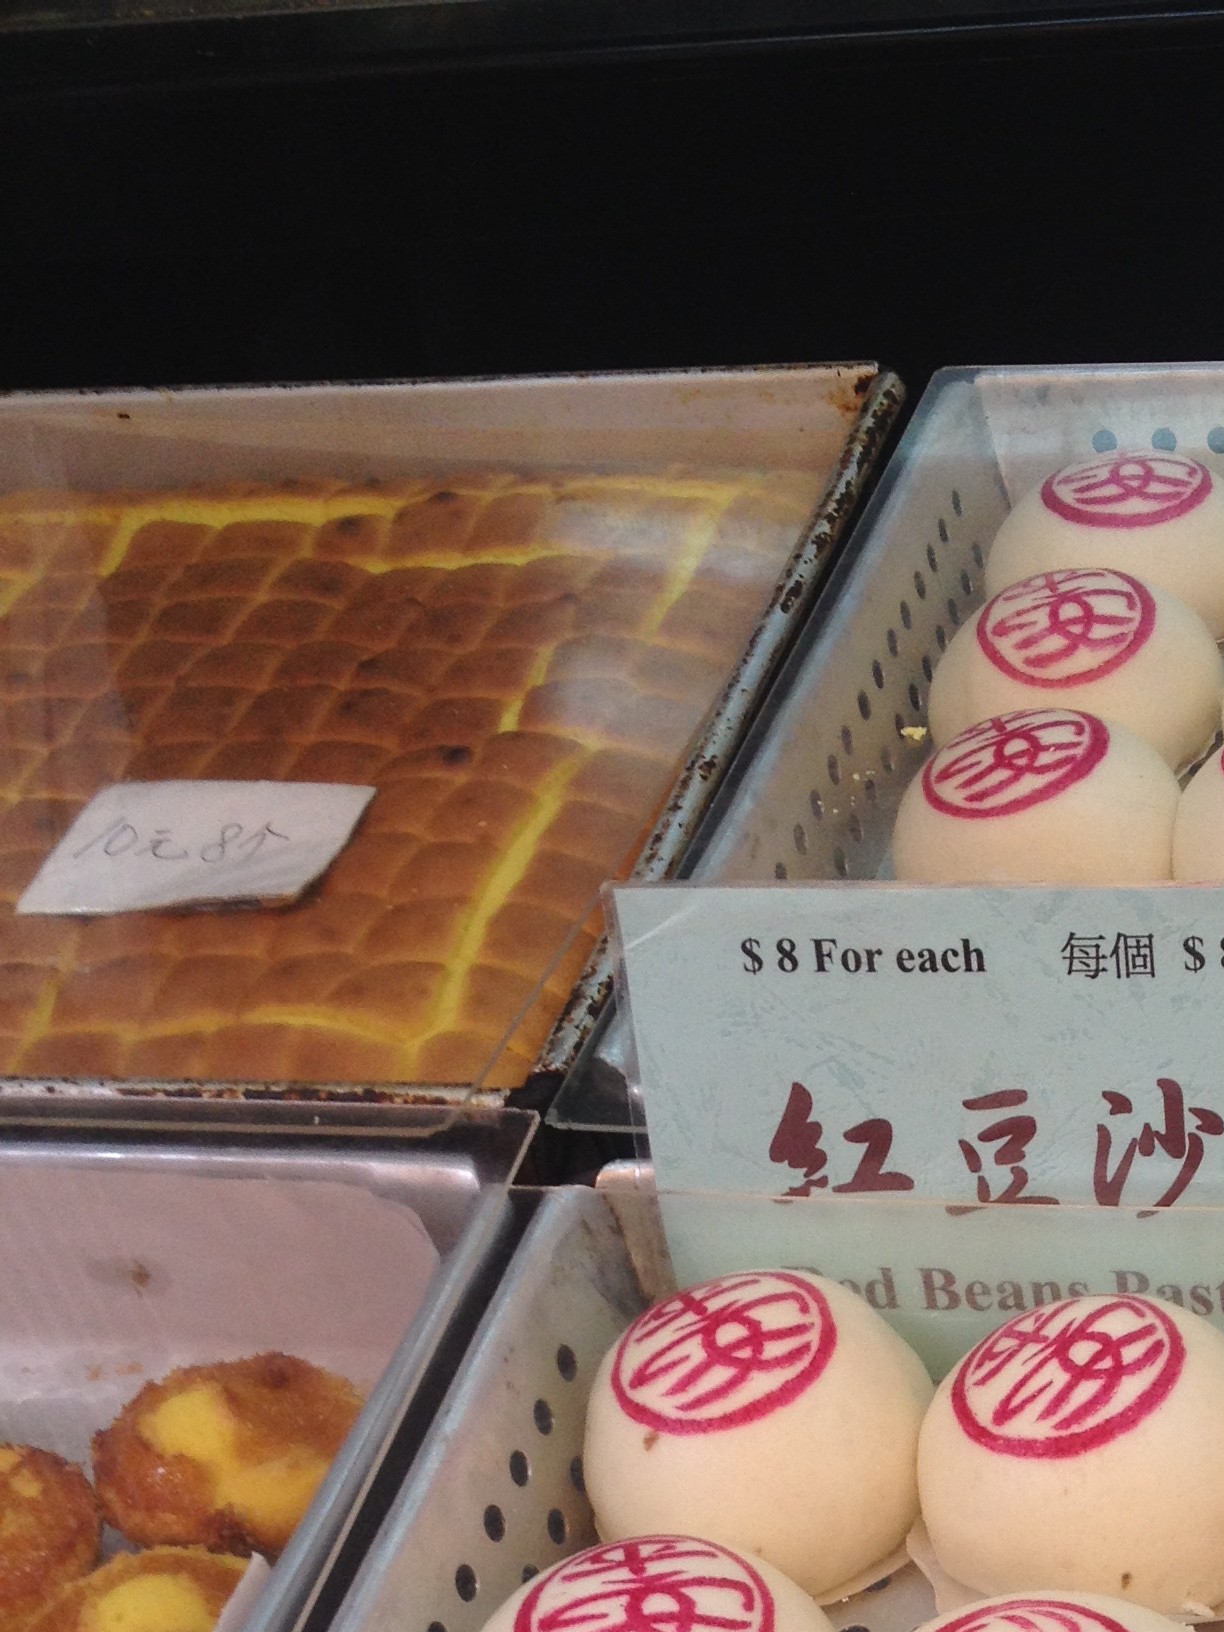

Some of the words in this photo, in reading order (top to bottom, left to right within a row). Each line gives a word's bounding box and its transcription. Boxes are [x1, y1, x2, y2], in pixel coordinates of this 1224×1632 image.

[813, 938, 884, 975] For
[895, 935, 987, 974] each
[1060, 930, 1156, 980] 每個
[917, 1267, 1088, 1312] Beans
